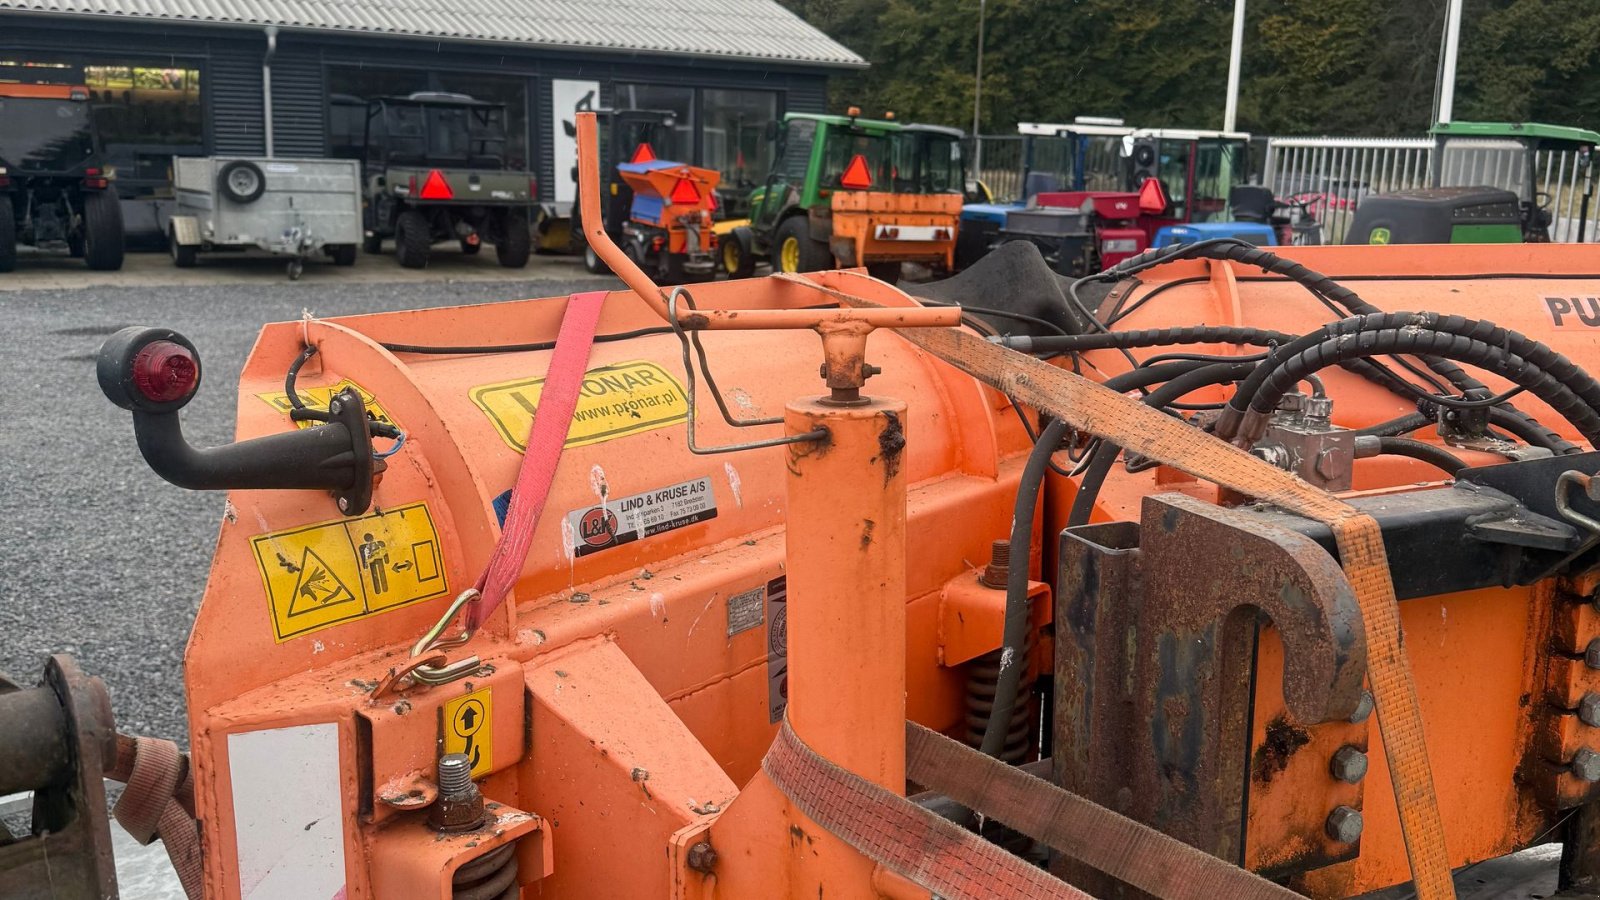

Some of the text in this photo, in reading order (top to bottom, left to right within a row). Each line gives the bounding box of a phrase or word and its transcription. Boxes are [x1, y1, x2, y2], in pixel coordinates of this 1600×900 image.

[1544, 297, 1600, 327] PU
[573, 389, 678, 422] www.pronar.pl
[621, 481, 706, 512] LIND & KRUSE A/S
[583, 514, 615, 539] L&K
[670, 510, 680, 518] Fax
